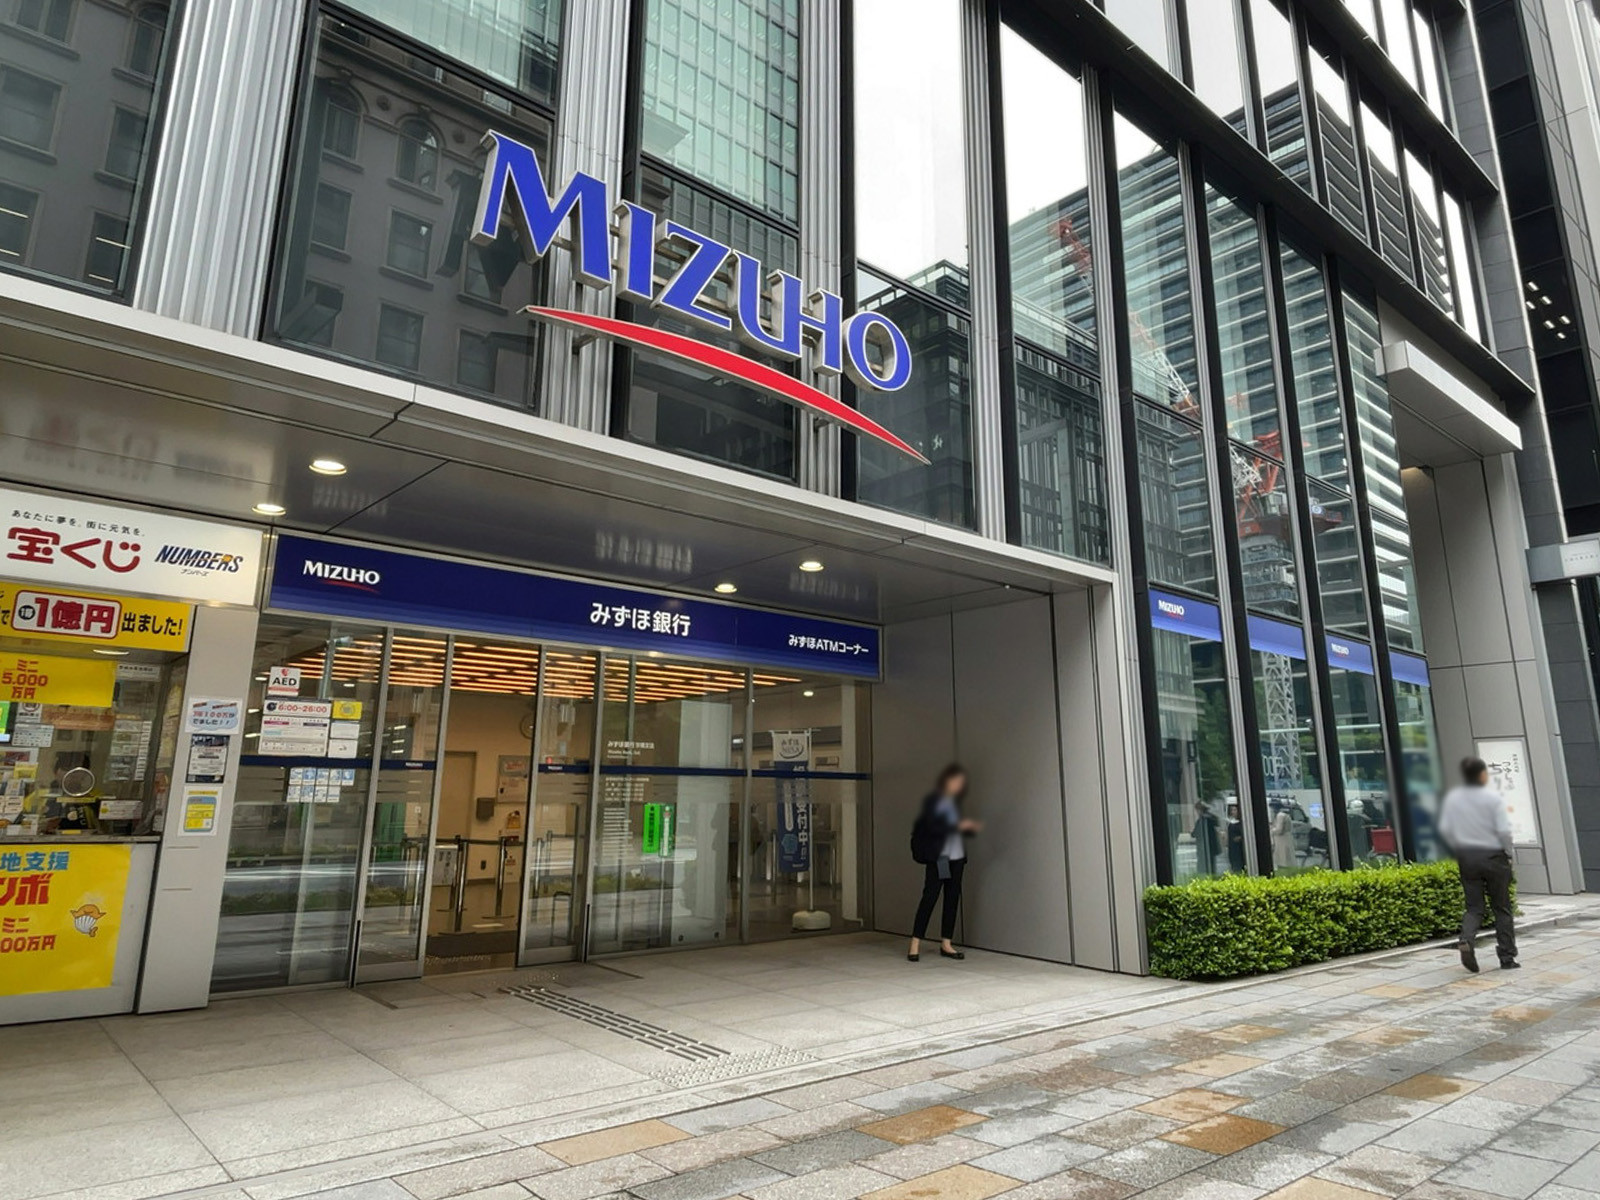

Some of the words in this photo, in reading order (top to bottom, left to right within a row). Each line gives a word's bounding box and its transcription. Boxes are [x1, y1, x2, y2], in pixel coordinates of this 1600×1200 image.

[471, 129, 912, 391] MIZUHO
[6, 527, 142, 574] 宝くじ
[154, 544, 244, 573] NUMBERS
[303, 560, 380, 585] MIZUHO
[34, 597, 115, 634] 1億円
[590, 602, 691, 637] みずほ銀行
[1158, 599, 1185, 617] MIZUHO
[788, 634, 870, 656] みずほATMコーナー
[17, 659, 39, 673] ミニ
[11, 686, 36, 699] 万円
[272, 677, 297, 686] AED
[2, 917, 30, 933] ミニ
